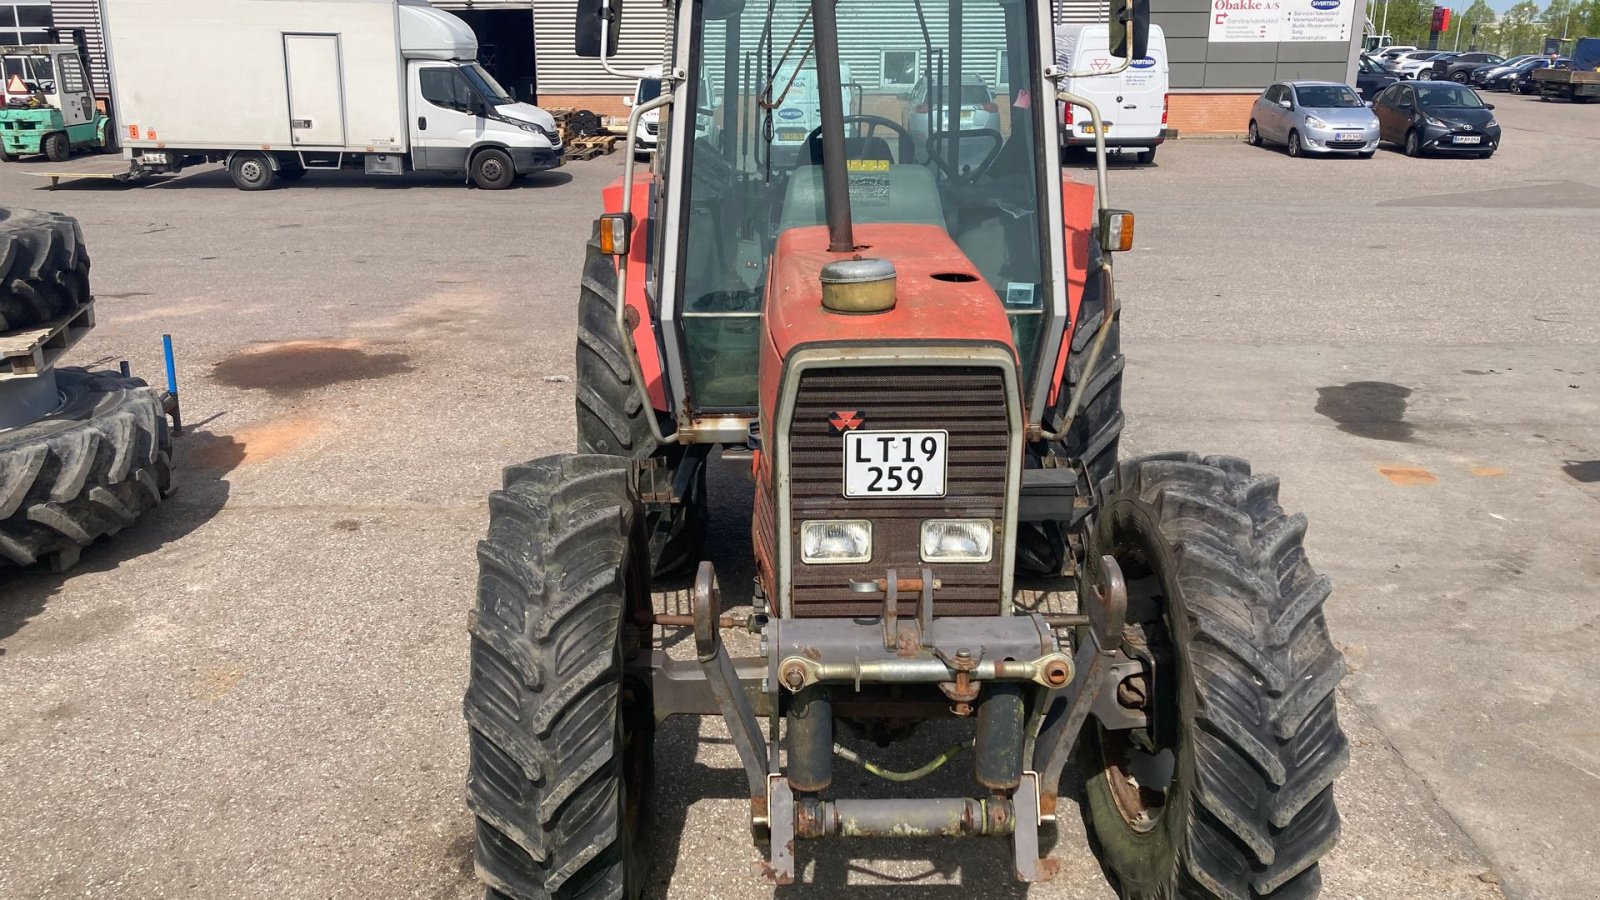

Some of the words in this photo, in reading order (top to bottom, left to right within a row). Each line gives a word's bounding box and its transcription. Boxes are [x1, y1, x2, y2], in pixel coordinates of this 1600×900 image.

[1215, 0, 1262, 10] Øbakke
[1264, 2, 1280, 10] A/S
[867, 466, 923, 491] 259
